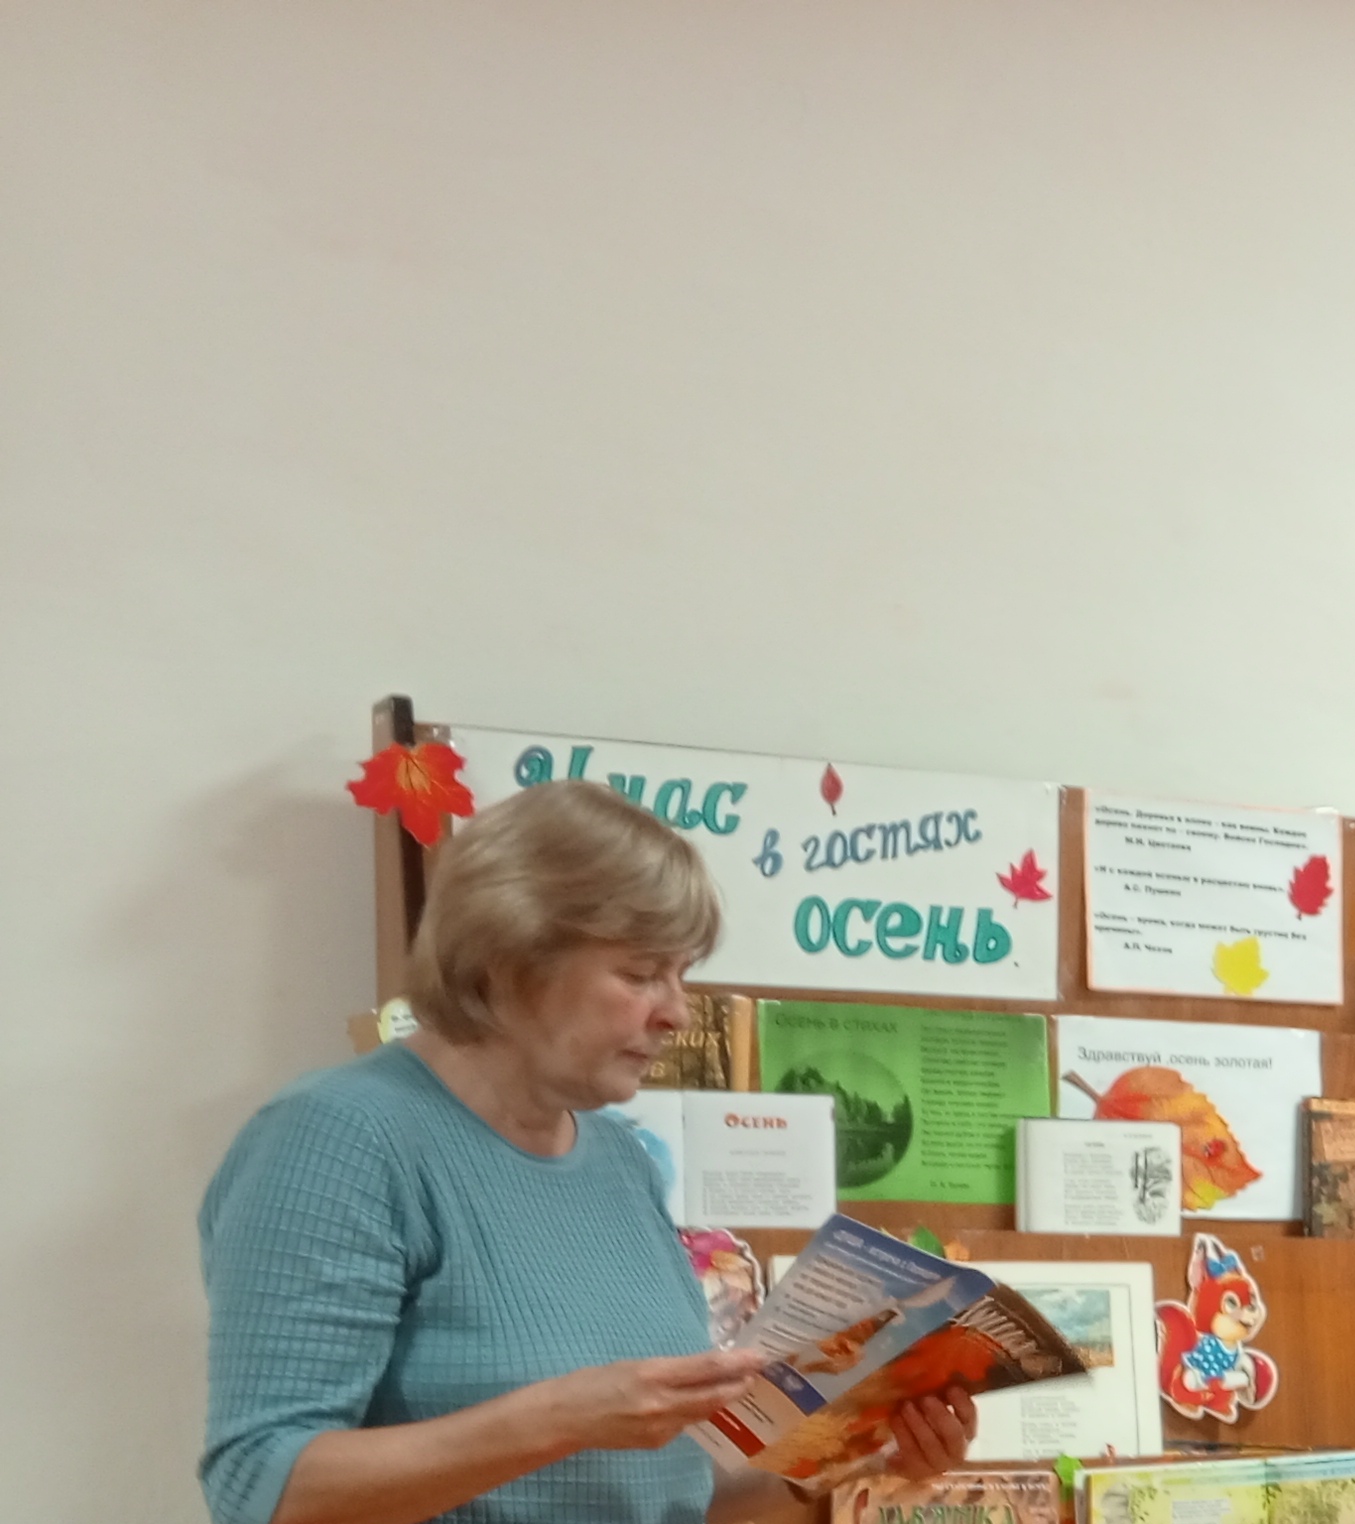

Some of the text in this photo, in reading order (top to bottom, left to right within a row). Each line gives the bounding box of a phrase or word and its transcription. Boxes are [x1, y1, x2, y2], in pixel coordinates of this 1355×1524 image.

[752, 807, 983, 878] в гостях
[794, 895, 1012, 964] осень
[1078, 1047, 1161, 1065] Здравствуй
[1214, 1056, 1273, 1071] золотая!
